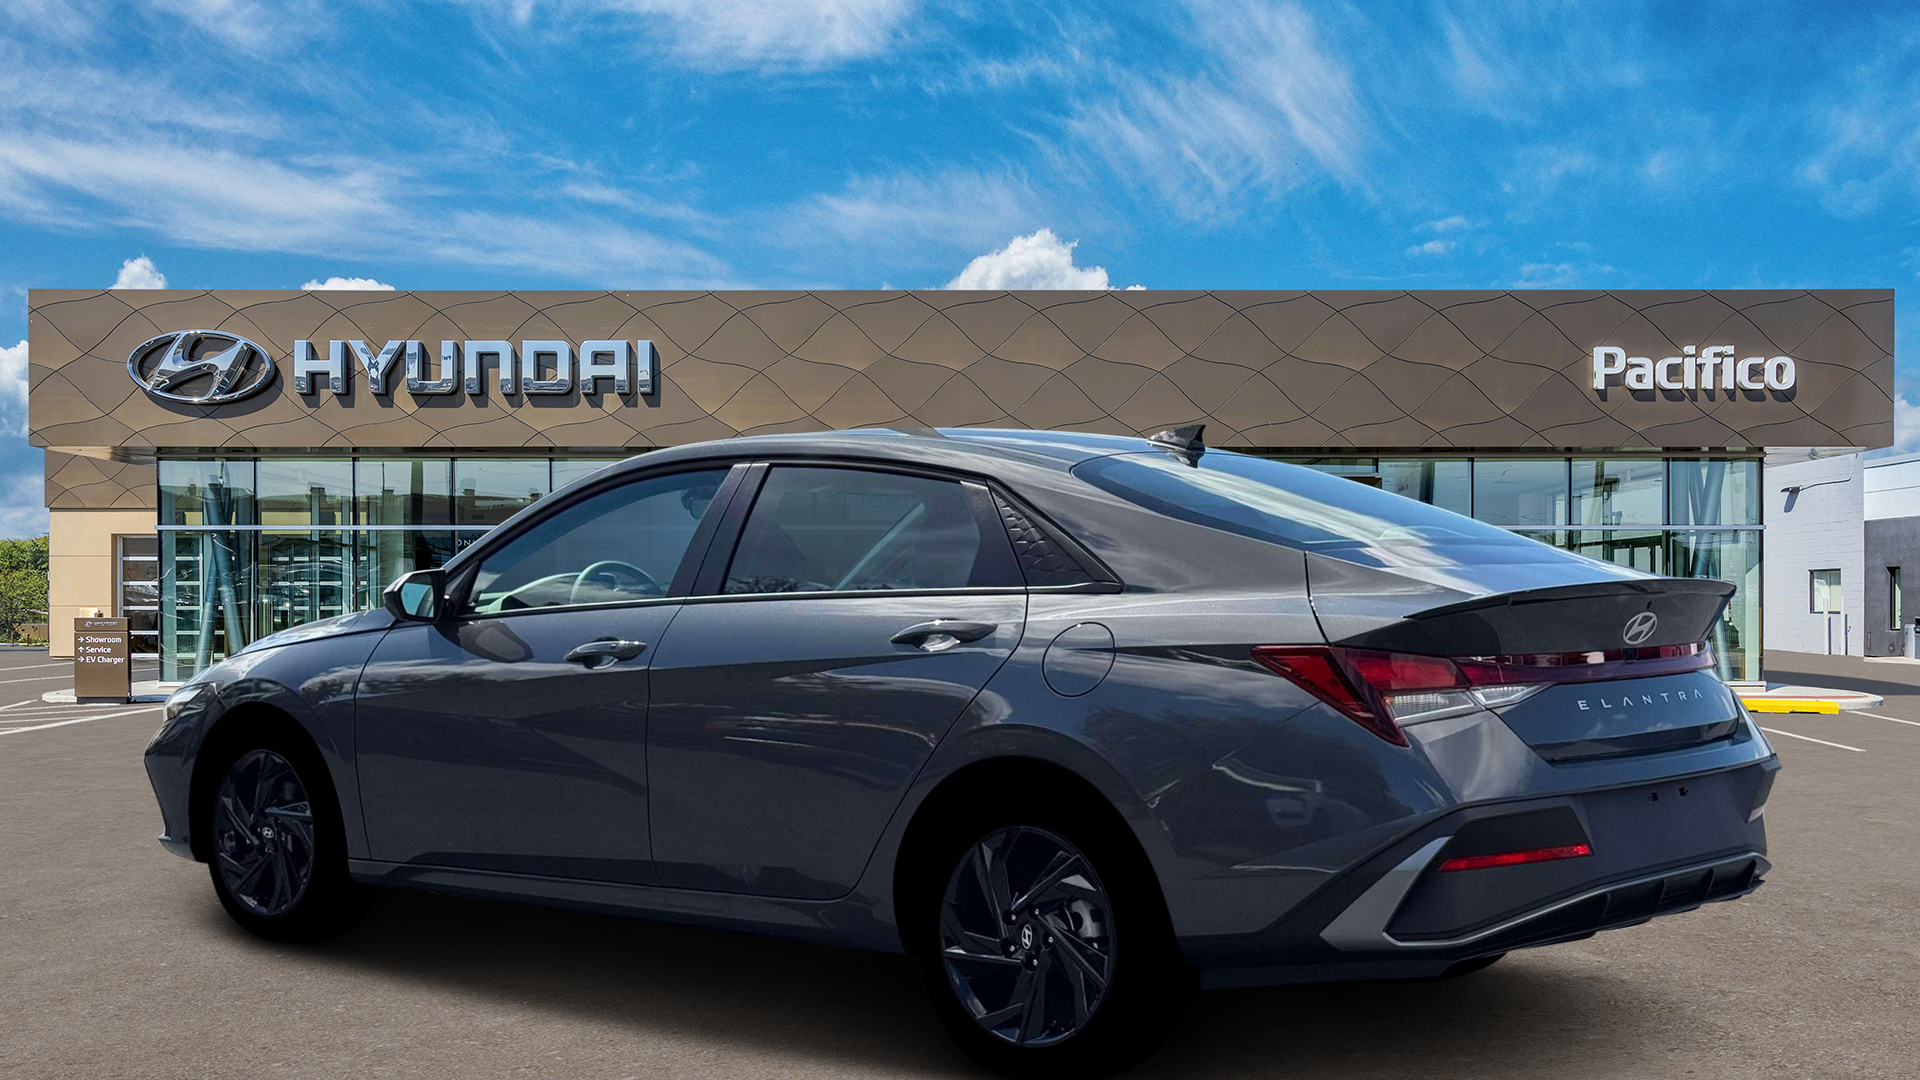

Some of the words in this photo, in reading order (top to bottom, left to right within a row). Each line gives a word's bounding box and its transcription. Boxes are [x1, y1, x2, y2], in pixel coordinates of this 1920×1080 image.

[294, 339, 654, 395] HYUNDAI
[1593, 345, 1796, 391] Pacifico
[97, 656, 125, 664] Charger
[1577, 689, 1703, 711] ELANTRA
